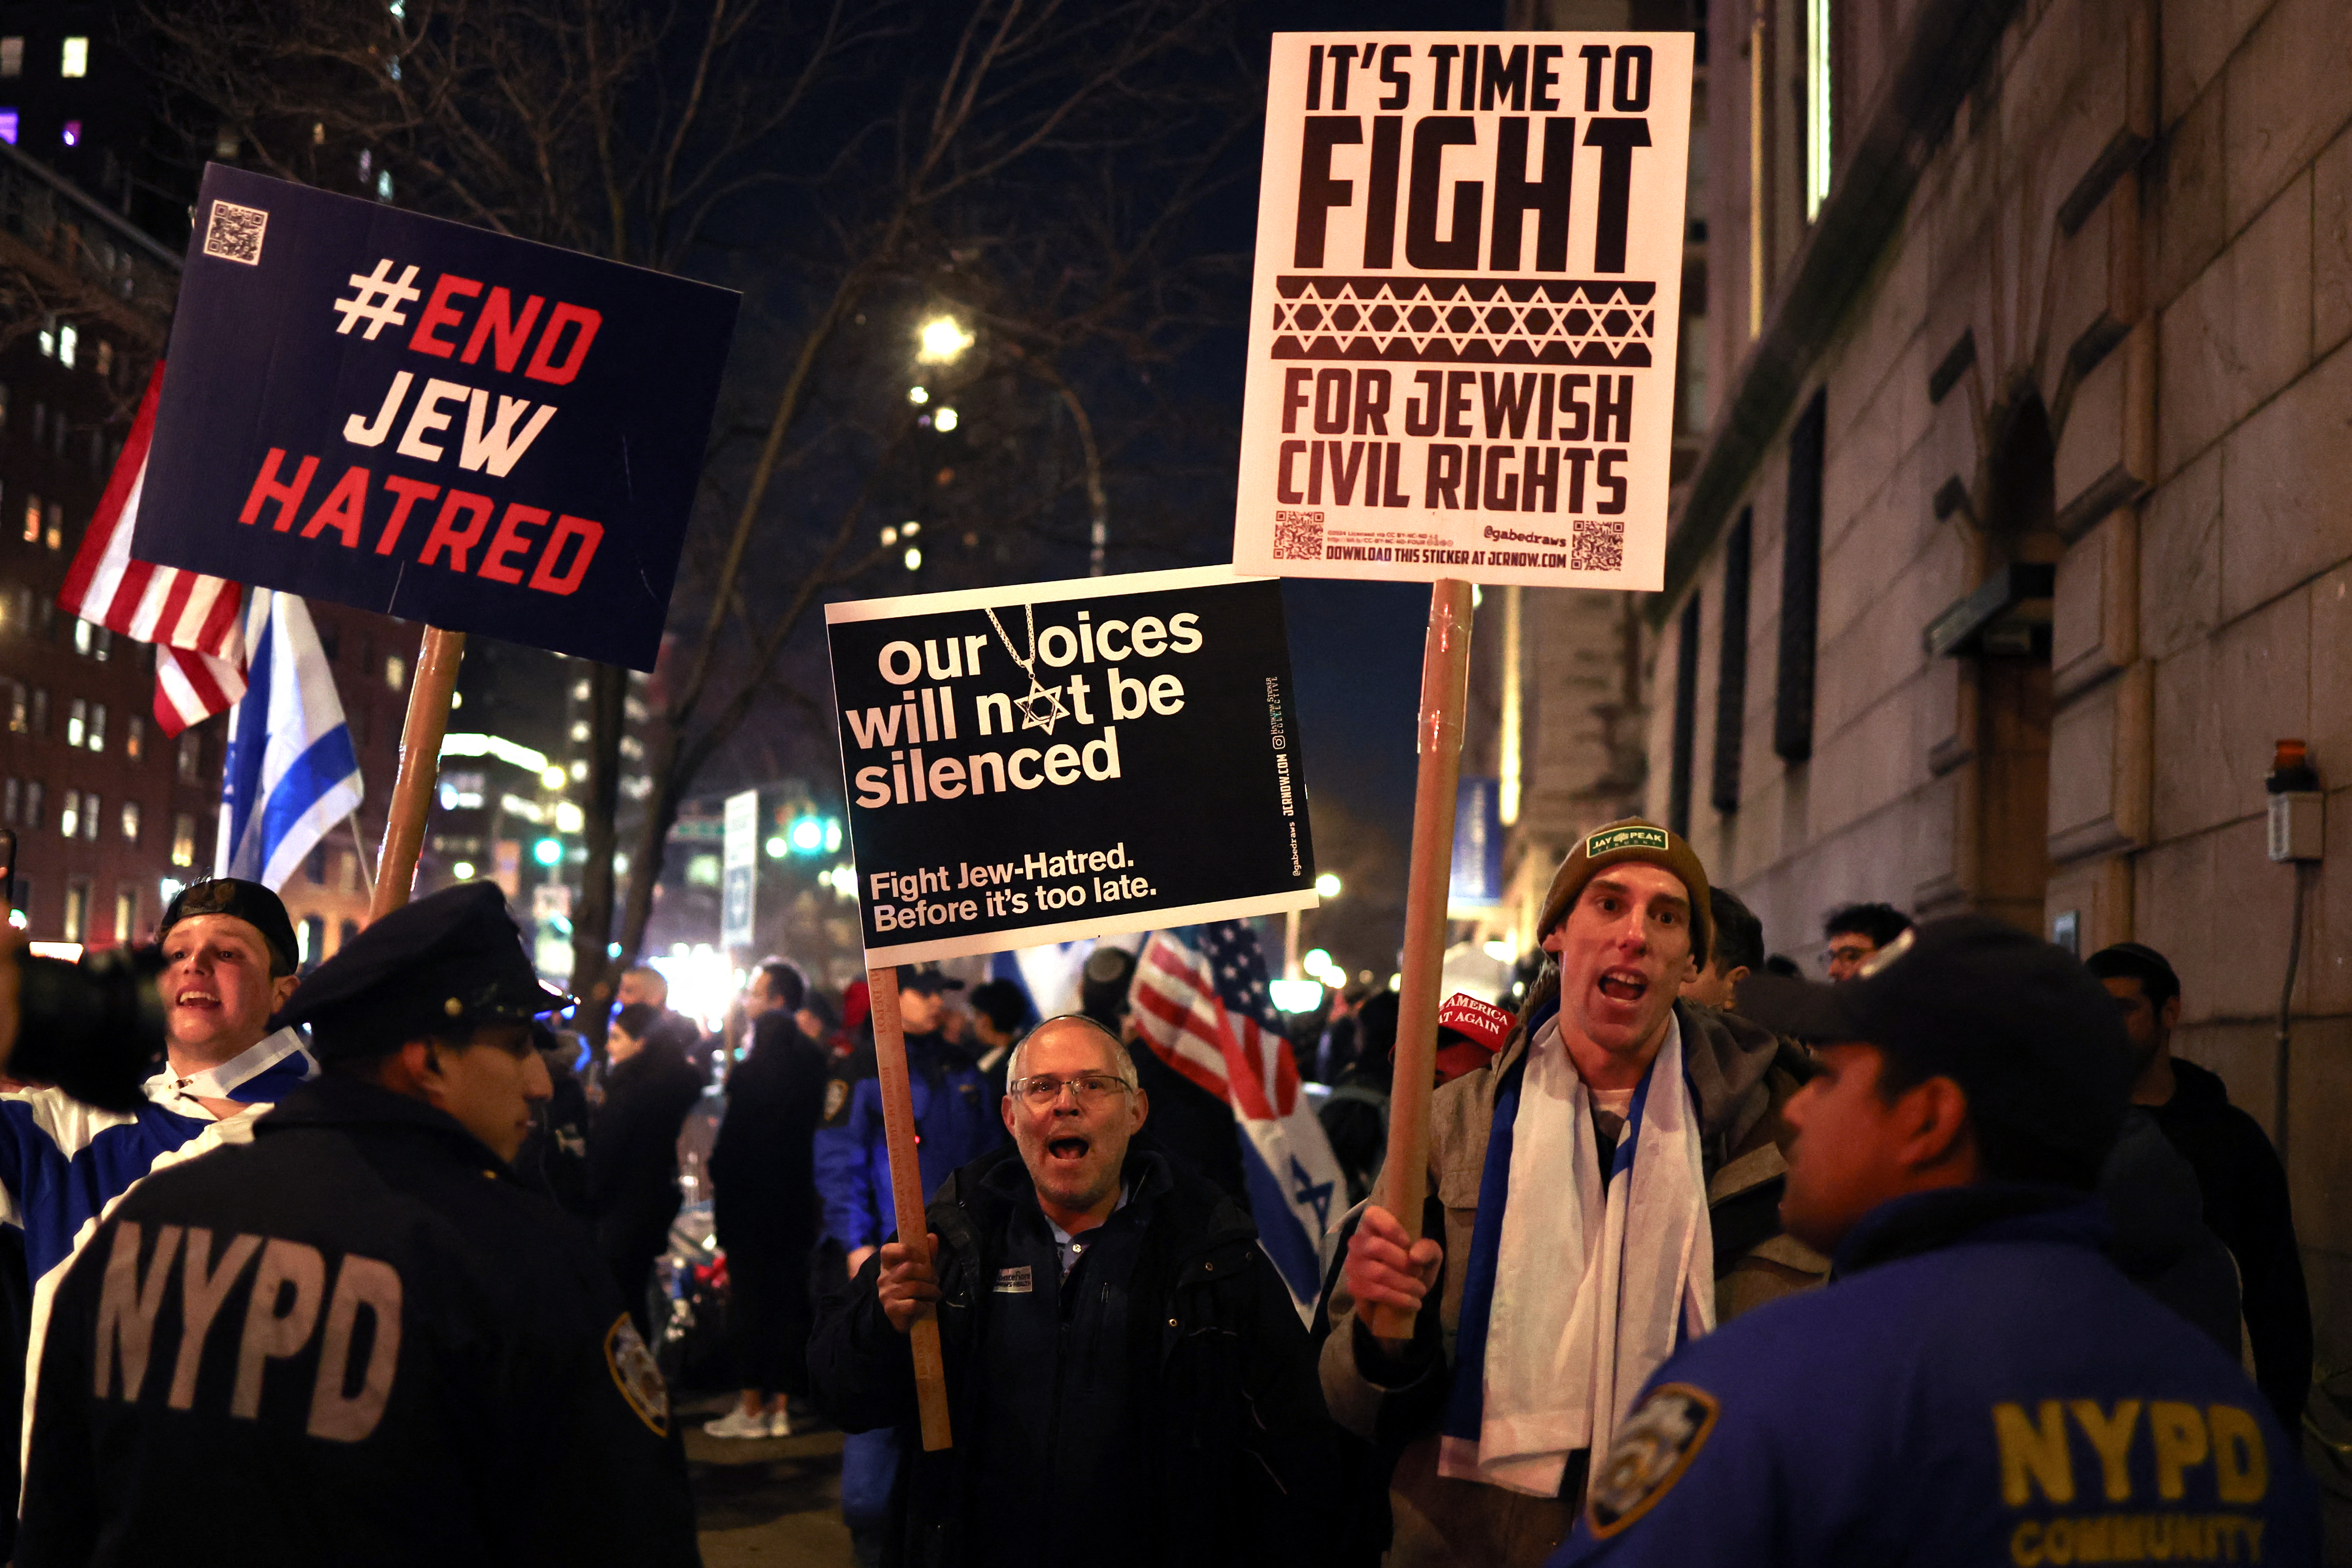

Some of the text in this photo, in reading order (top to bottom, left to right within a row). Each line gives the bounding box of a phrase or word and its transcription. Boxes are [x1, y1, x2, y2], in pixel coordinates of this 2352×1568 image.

[1306, 43, 1653, 112] IT'S TIME TO
[1294, 115, 1652, 274] FIGHT
[333, 258, 602, 386] #END
[342, 370, 558, 478] JEW
[1281, 367, 1634, 443] FOR JEWISH
[1277, 439, 1629, 515] CIVIL RIGHTS
[239, 447, 605, 596] HATRED
[1326, 545, 1566, 568] DOWNLOAD THIS STICKER AT JCRNOW.COM
[1484, 525, 1567, 547] @gabedraws
[878, 634, 987, 685] our
[846, 685, 956, 750] will
[1107, 667, 1185, 720] be
[855, 725, 1121, 809] silenced
[1276, 753, 1301, 876] @gabedraws JCRNOW.COM
[1592, 832, 1662, 849] JAY PEAK
[870, 842, 1134, 902] Fight Jew-Hatred.
[874, 875, 1157, 933] Before it's too late.
[1446, 995, 1508, 1026] AMERICA
[1454, 1011, 1500, 1034] AGAIN
[93, 1220, 403, 1443] NYPD
[1993, 1398, 2269, 1505] NYPD
[2011, 1514, 2265, 1567] COMMUNITY
